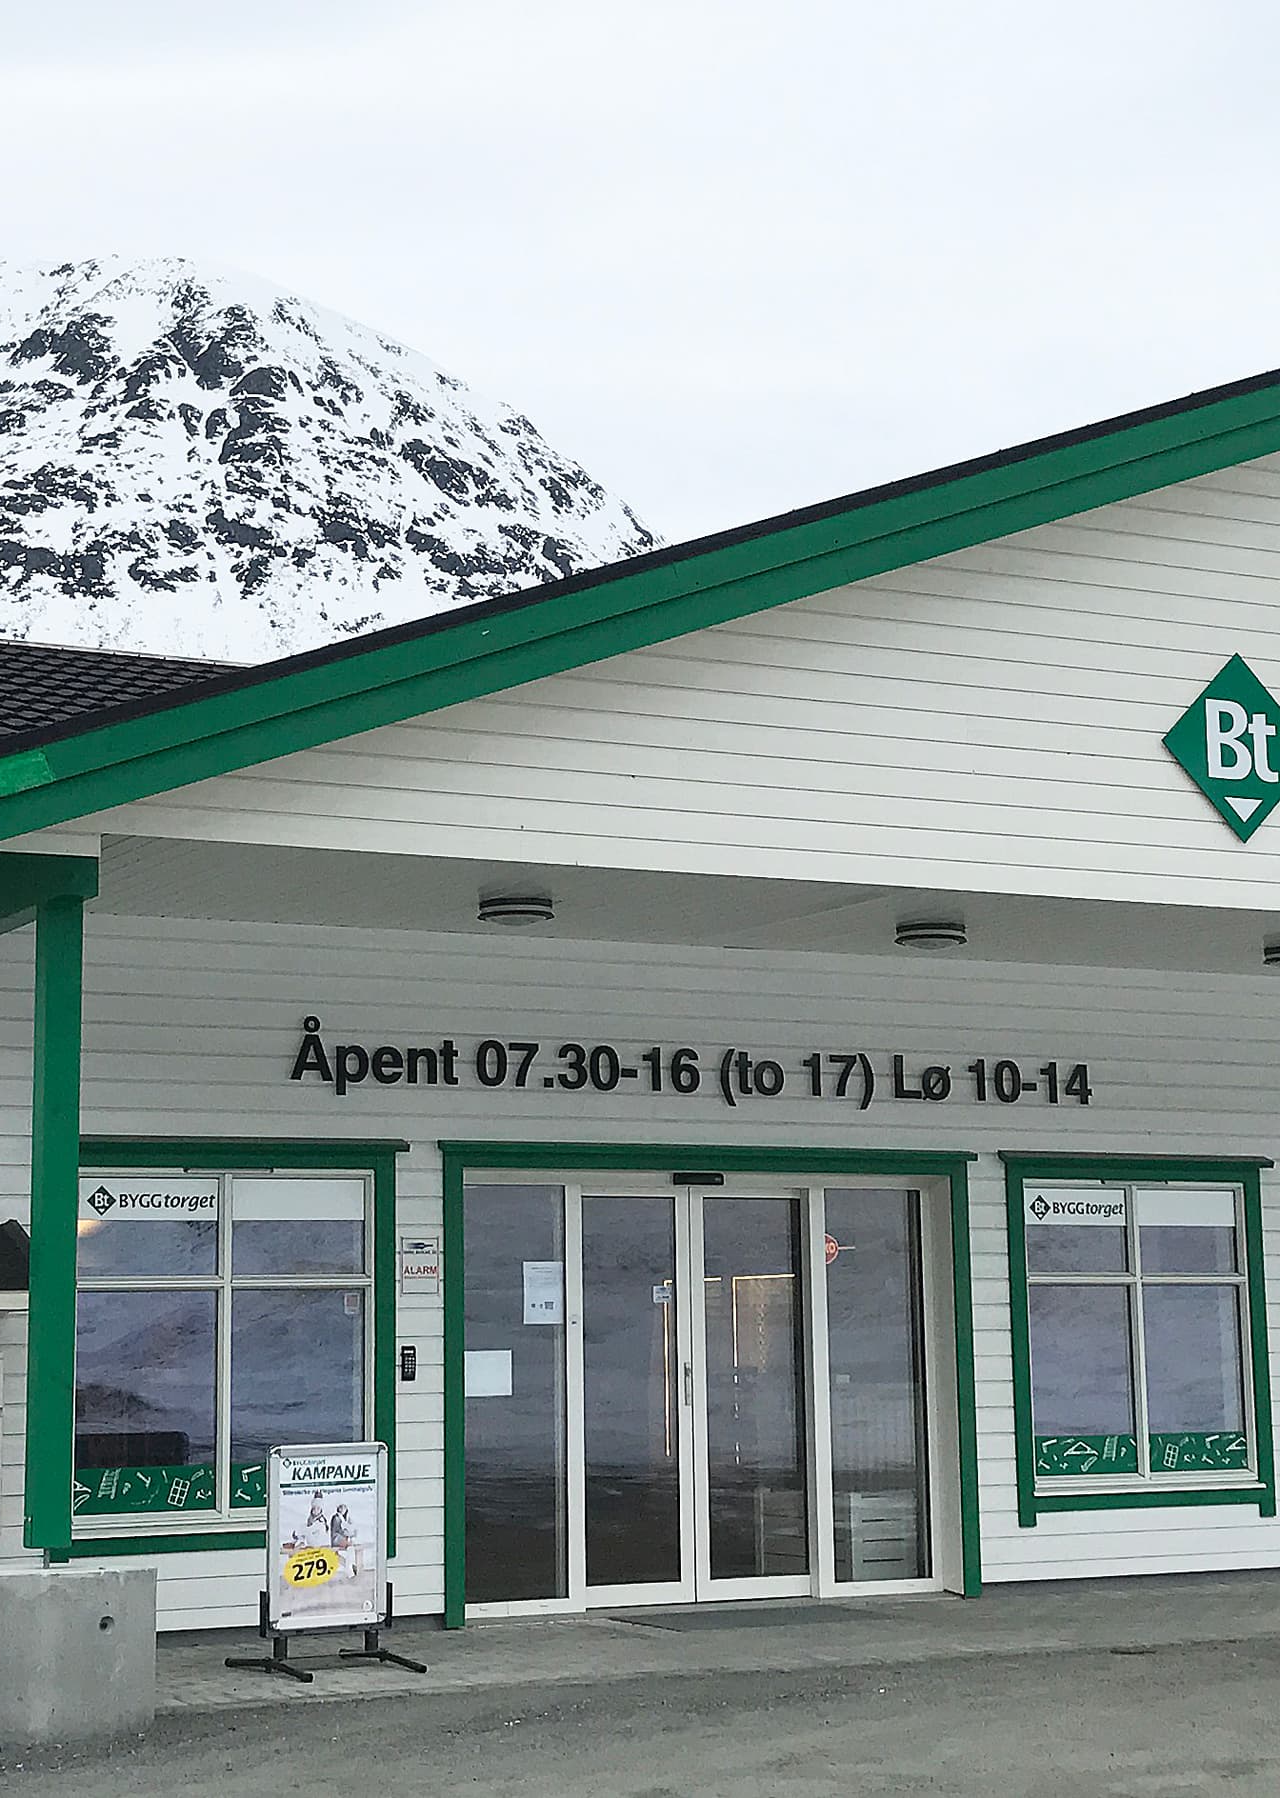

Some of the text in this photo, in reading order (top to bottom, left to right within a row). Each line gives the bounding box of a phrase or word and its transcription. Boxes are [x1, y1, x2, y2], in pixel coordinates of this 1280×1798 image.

[1205, 698, 1279, 783] Bt
[290, 1015, 1093, 1111] Åpent 07.30-16 (to 17) Lø 10-14
[94, 1192, 110, 1207] Bt
[119, 1193, 216, 1212] BYGGtorget
[1052, 1202, 1124, 1218] BYGGtorget
[404, 1266, 437, 1274] ALARM
[292, 1464, 371, 1480] KAMPANJE
